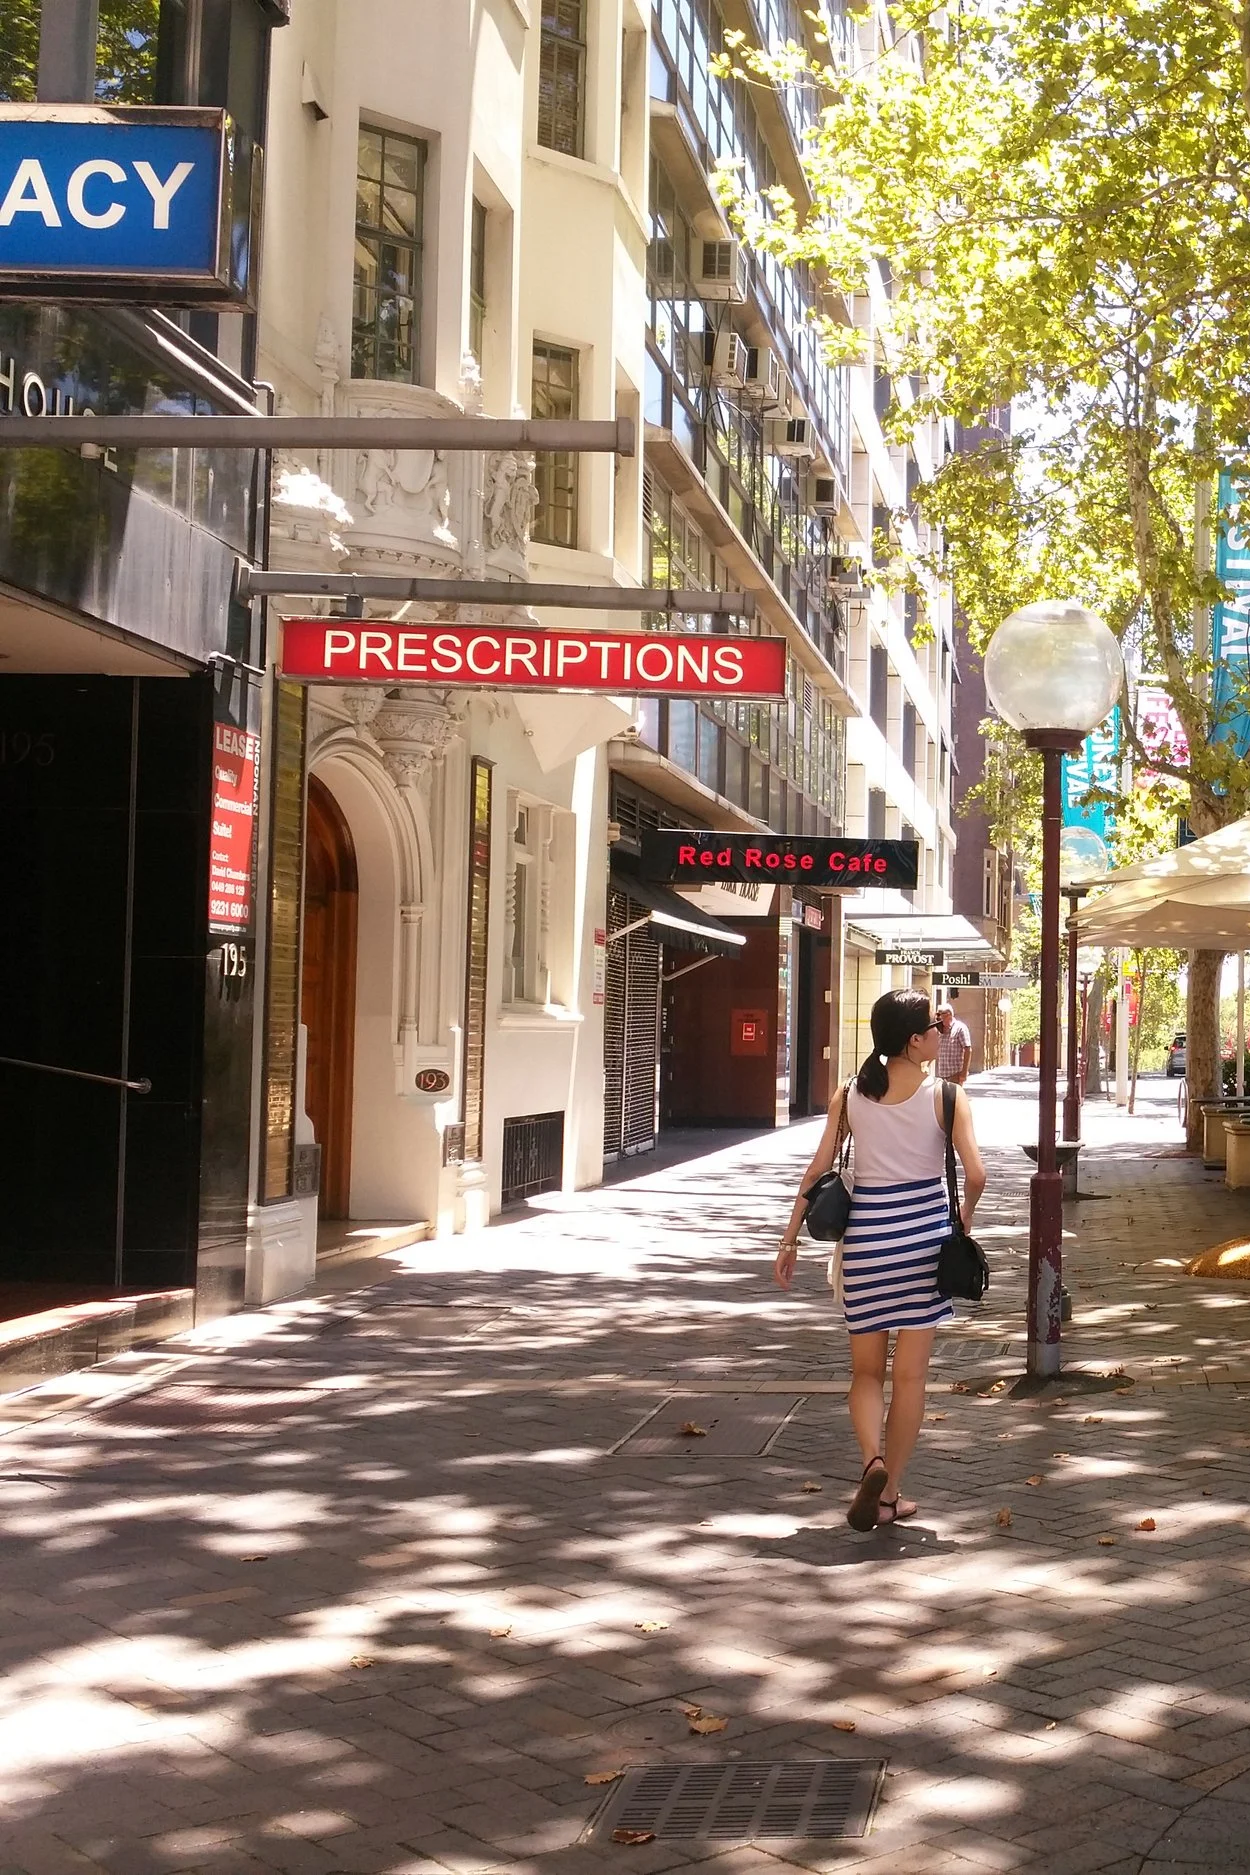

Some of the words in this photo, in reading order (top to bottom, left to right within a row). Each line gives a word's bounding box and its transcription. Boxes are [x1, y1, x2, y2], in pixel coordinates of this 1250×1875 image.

[1, 158, 195, 230] ACY
[323, 629, 745, 685] PRESCRIPTIONS
[216, 726, 254, 761] LEASE
[214, 765, 238, 788] Quality
[252, 740, 261, 816] NOONAN
[214, 792, 253, 817] Commercial
[678, 845, 731, 867] Red
[745, 848, 814, 871] Rose
[828, 851, 888, 874] Cafe
[211, 900, 230, 917] 9231
[220, 942, 247, 977] 195
[885, 954, 934, 964] PROVOST
[942, 974, 971, 985] Posh!
[420, 1072, 447, 1090] 193
